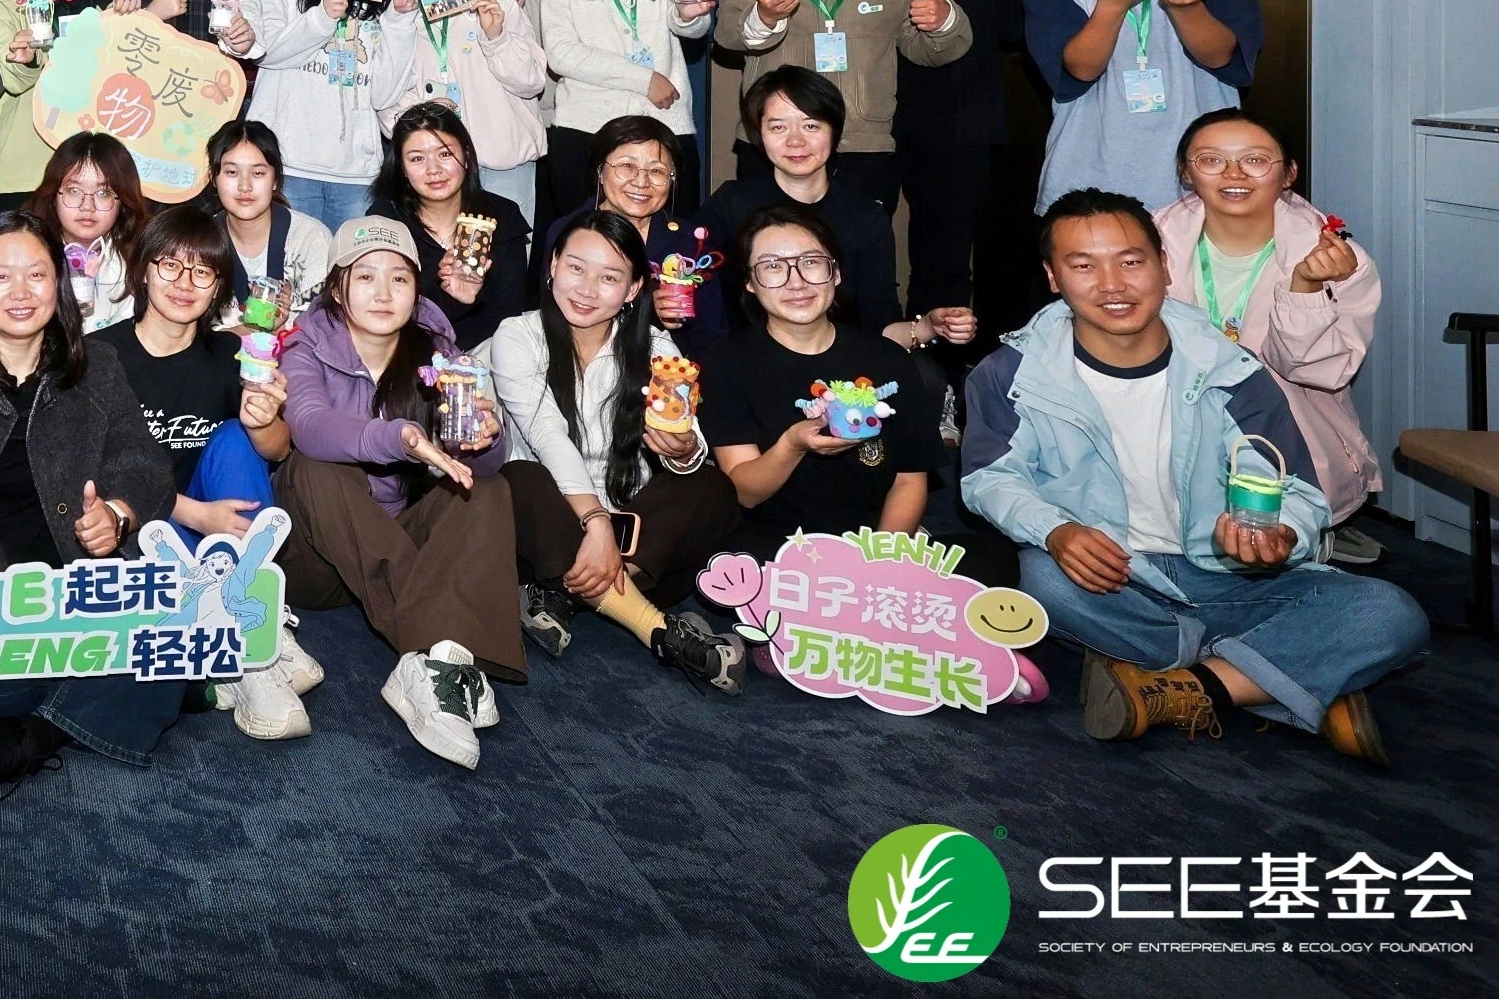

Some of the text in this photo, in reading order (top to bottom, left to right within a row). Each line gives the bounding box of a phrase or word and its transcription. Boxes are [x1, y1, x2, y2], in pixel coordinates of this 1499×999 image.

[368, 226, 399, 242] SEE
[847, 528, 965, 577] YEAH!
[768, 567, 957, 641] 日子滚烫
[132, 627, 242, 676] 轻松
[787, 626, 983, 708] 万物生长
